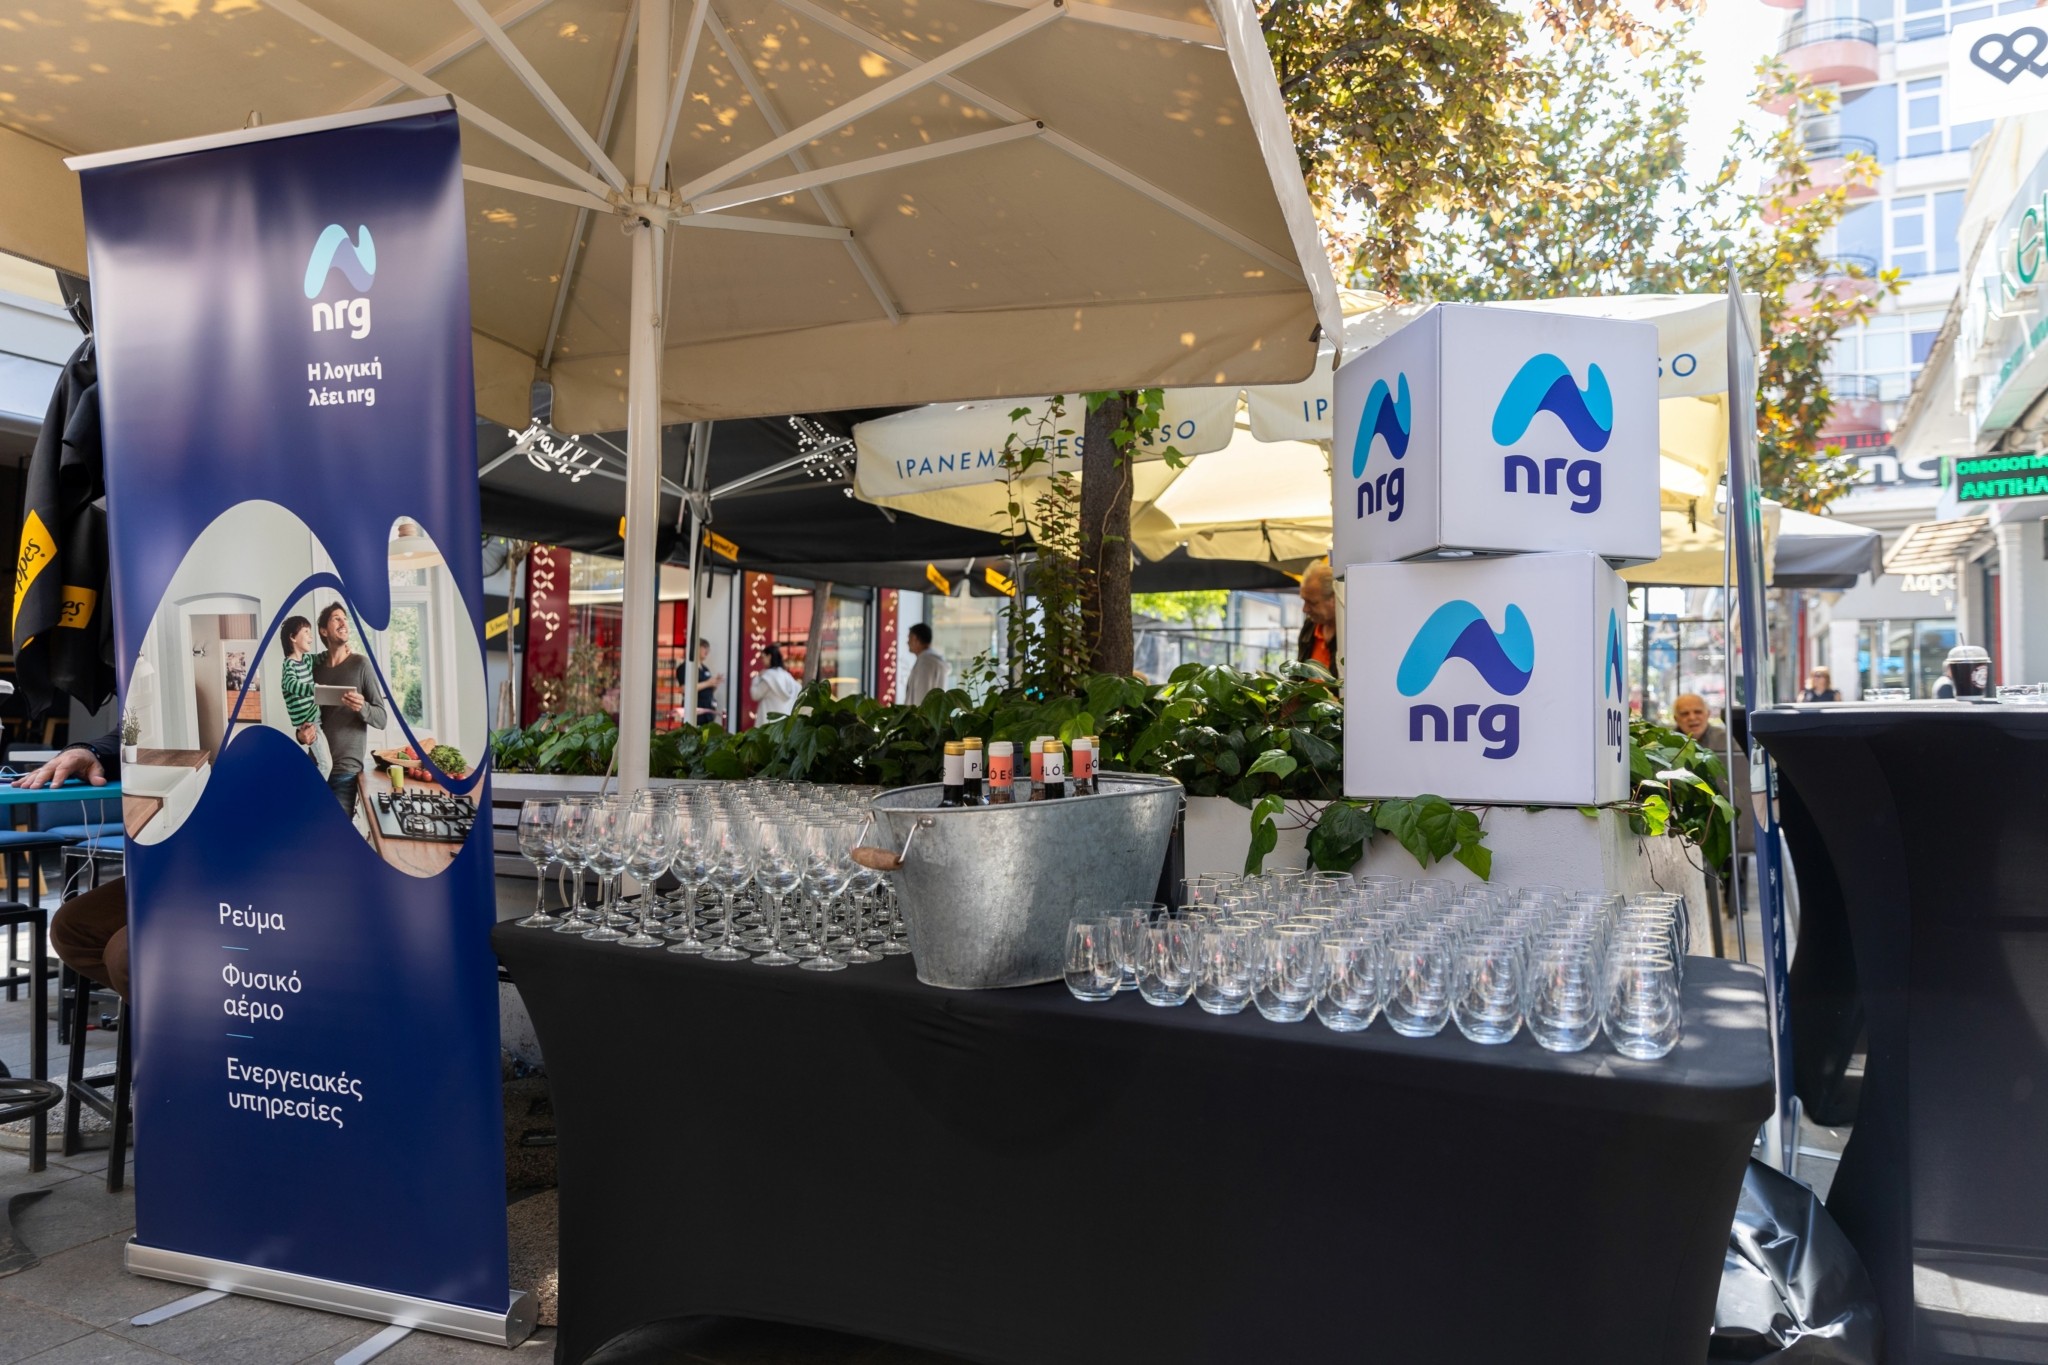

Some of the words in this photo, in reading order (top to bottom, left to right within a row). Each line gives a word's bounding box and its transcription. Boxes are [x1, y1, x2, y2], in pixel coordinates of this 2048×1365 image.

[312, 298, 371, 340] nrg
[307, 362, 321, 382] Η
[324, 357, 382, 383] λογική
[308, 386, 345, 407] λέει
[347, 387, 376, 407] nrg
[1358, 467, 1405, 523] nrg
[1504, 454, 1602, 514] nrg
[1409, 703, 1520, 760] nrg
[1607, 707, 1622, 764] nrg
[219, 902, 286, 935] Ρεύμα
[221, 963, 302, 995] Φυσικό
[223, 994, 284, 1024] αέριο
[227, 1057, 363, 1102] Ενεργειακές
[228, 1090, 344, 1129] υπηρεσίες
